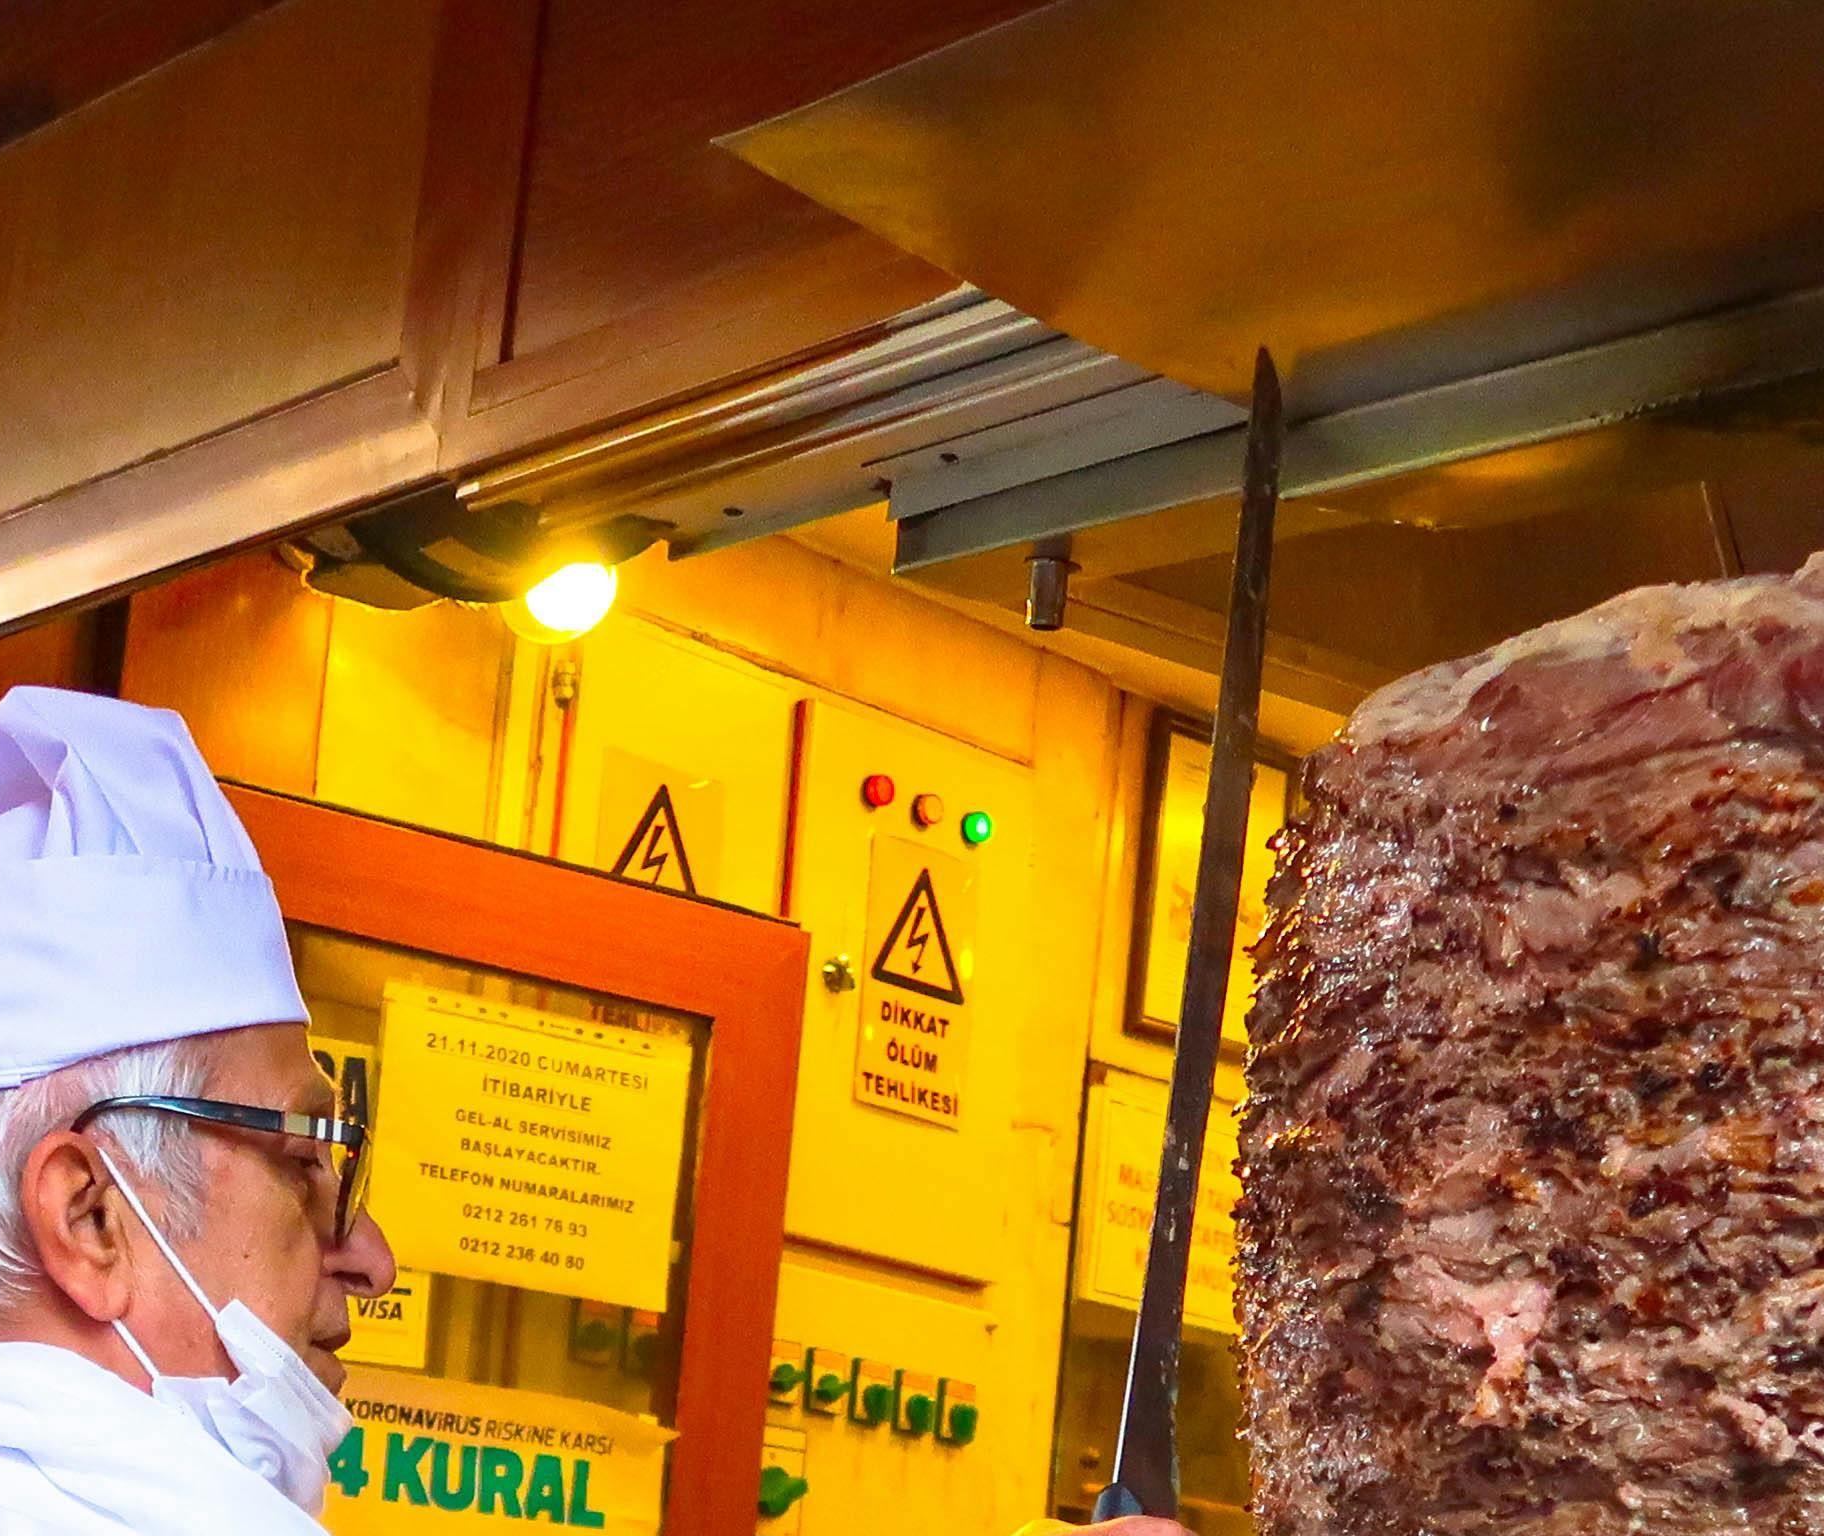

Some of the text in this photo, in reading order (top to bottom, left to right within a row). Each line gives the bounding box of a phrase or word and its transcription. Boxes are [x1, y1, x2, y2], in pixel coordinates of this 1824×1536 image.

[880, 1000, 950, 1039] DİKKAT
[425, 1032, 648, 1091] 21.11.2020 CUMARTESİ
[886, 1037, 939, 1074] ÖLÜM
[481, 1073, 593, 1112] İTİBARİYLE
[862, 1071, 959, 1117] TEHLİKESİ
[455, 1108, 513, 1132] GEL-AL
[419, 1162, 635, 1214] TELEFON NUMARALARIMIZ
[462, 1203, 503, 1223] 0212
[509, 1211, 537, 1229] 261
[568, 1221, 587, 1237] 93
[459, 1236, 585, 1271] 0212 236 40 80
[356, 1298, 402, 1321] VISA
[344, 1397, 481, 1437] KORONAVİRUS
[382, 1432, 605, 1529] KURAL
